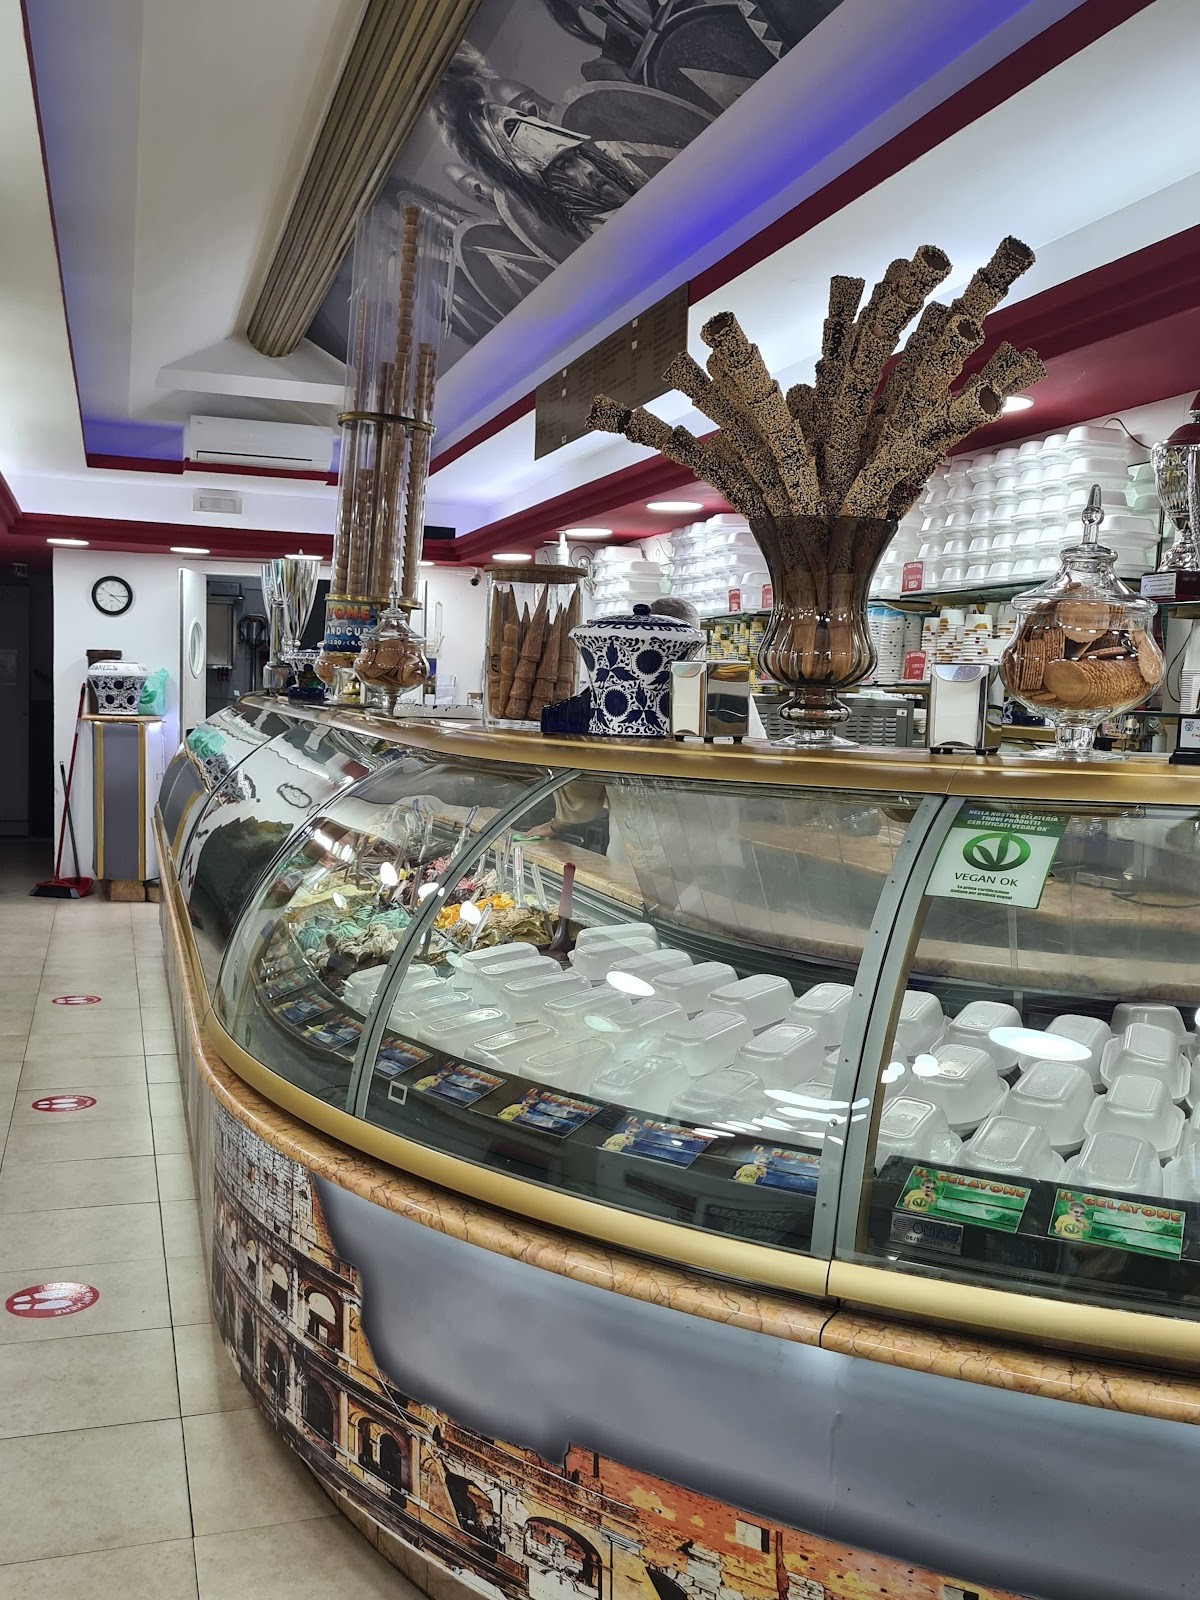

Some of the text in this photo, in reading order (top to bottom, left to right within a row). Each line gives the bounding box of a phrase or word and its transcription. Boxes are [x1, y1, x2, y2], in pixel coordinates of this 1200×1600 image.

[967, 820, 1011, 828] CERTIFICATI
[1003, 817, 1042, 826] PRODOTTI
[1020, 814, 1059, 822] GELATERIA
[955, 872, 1019, 887] VEGAN OK
[914, 1168, 1028, 1198] IL GELATONE
[1059, 1191, 1182, 1222] IL GELATONE
